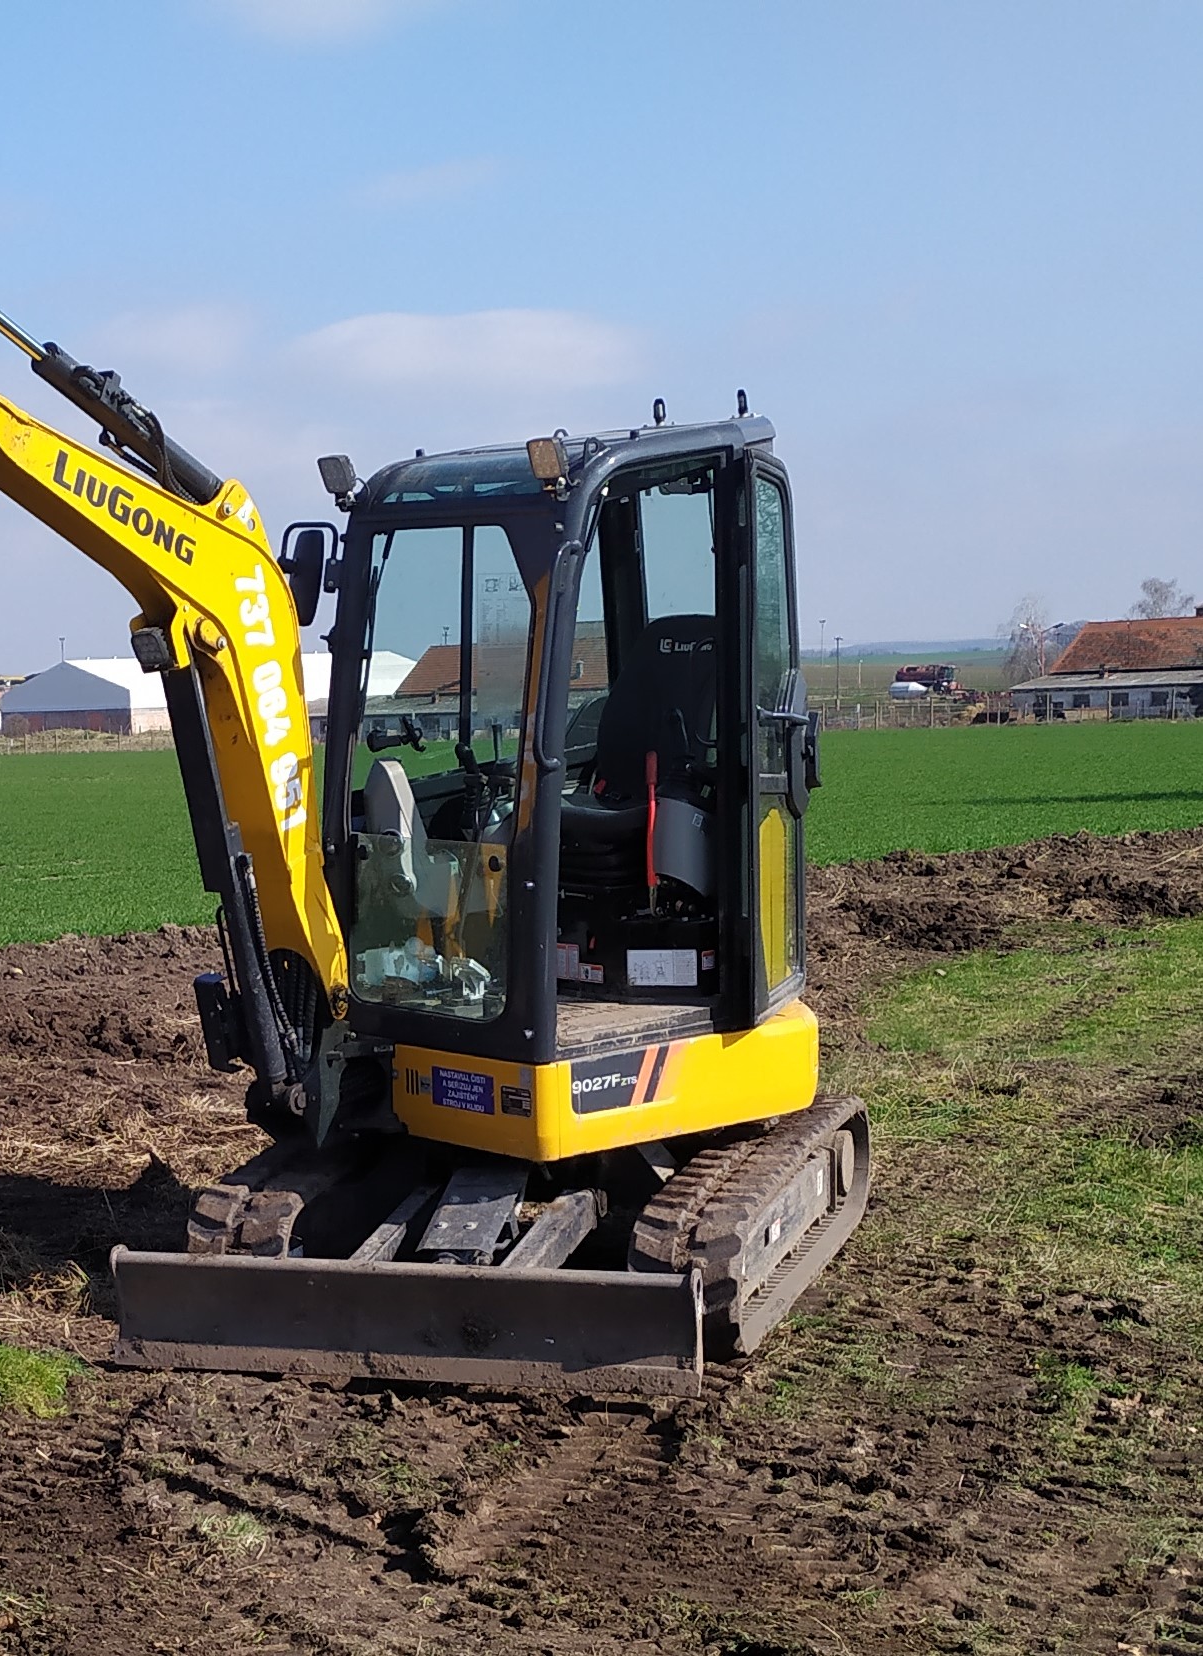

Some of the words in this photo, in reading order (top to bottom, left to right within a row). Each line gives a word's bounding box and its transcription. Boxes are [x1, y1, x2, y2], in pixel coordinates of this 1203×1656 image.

[235, 564, 275, 647] 737
[252, 660, 292, 746] 064
[270, 751, 307, 832] 951
[472, 1085, 484, 1094] JEN
